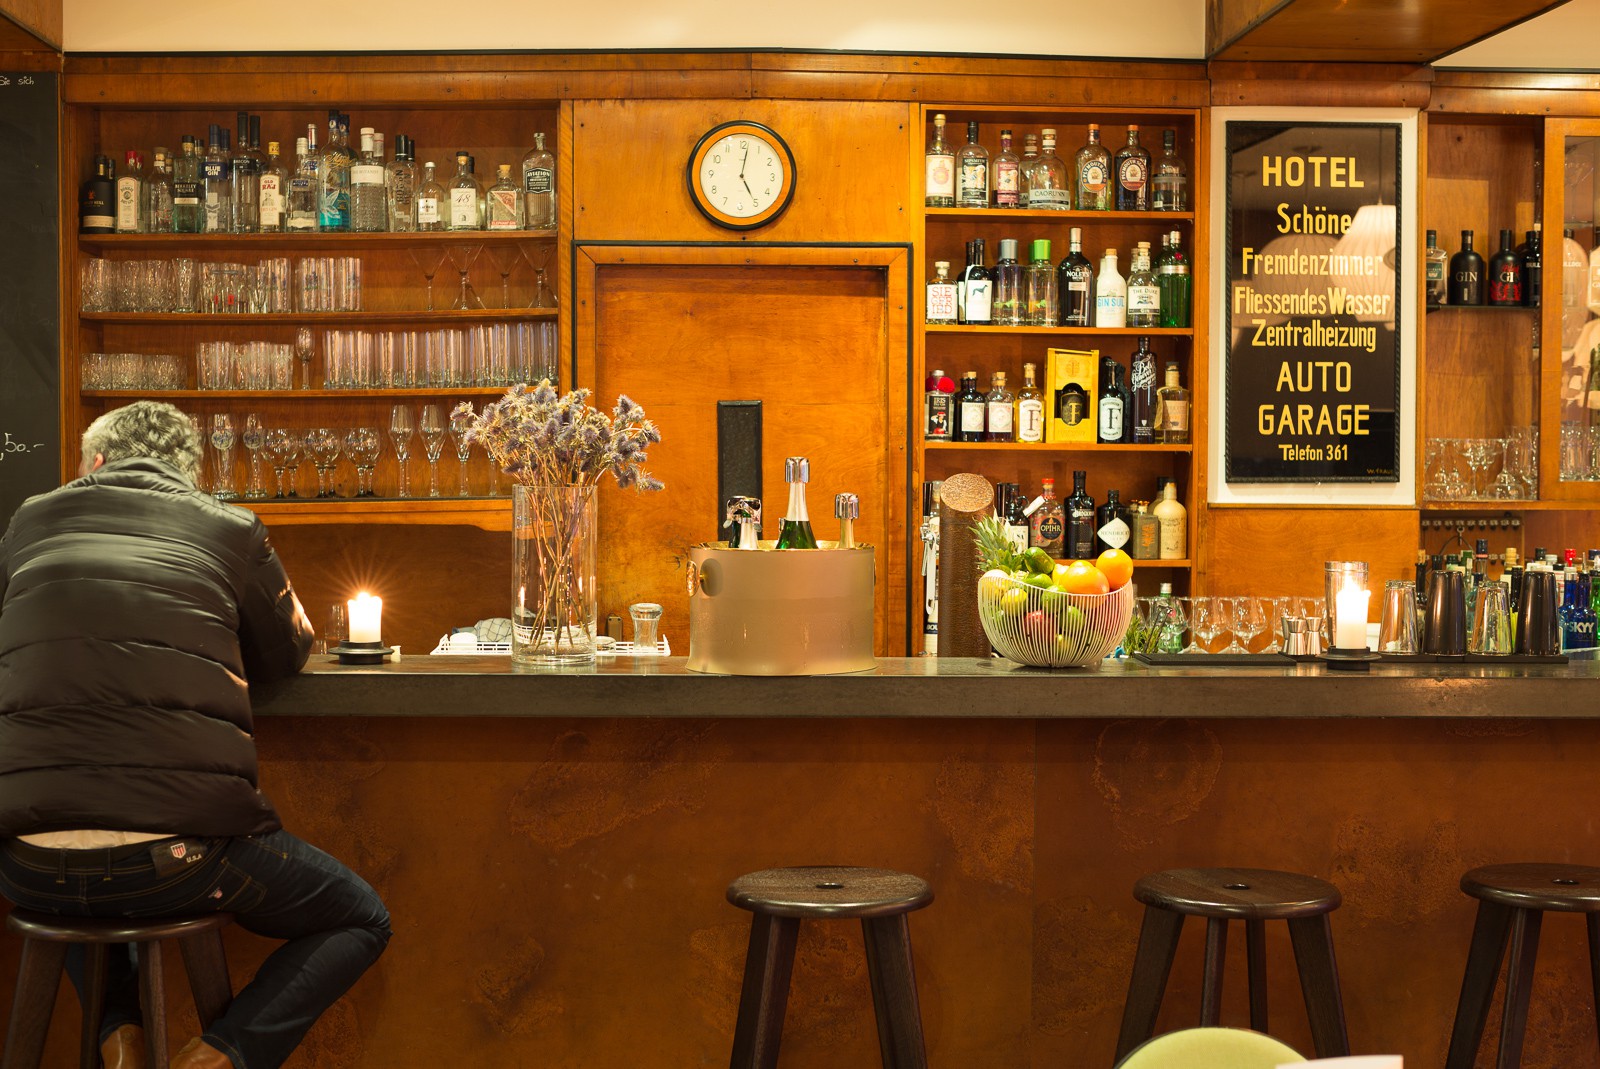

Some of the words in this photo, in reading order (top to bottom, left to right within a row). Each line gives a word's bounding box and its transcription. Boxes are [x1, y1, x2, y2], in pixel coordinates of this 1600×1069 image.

[18, 76, 35, 86] sich
[725, 144, 731, 153] 11
[713, 155, 721, 164] 10
[767, 157, 773, 167] 2
[708, 169, 714, 178] 9
[1262, 155, 1365, 188] HOTEL
[770, 173, 776, 182] 3
[711, 185, 717, 194] 8
[764, 188, 770, 196] 4
[1034, 190, 1065, 198] CAORUNN
[723, 197, 728, 206] 7
[753, 198, 759, 208] 5
[1276, 202, 1352, 235] Schöne
[1242, 247, 1384, 277] Fremdenzimmer
[1455, 271, 1478, 283] GIN
[931, 286, 952, 297] SIE
[1097, 297, 1109, 308] GIN
[1111, 297, 1125, 308] SUL
[1234, 286, 1327, 316] Fliessendes
[1327, 286, 1391, 316] Wasser
[930, 305, 953, 315] IED
[1251, 318, 1377, 353] Zentralheizung
[1275, 361, 1352, 393] AUTO
[1258, 404, 1370, 436] GARAGE
[1278, 444, 1323, 461] Telefon
[1326, 444, 1348, 461] 361
[1040, 524, 1061, 532] OPIHR
[1569, 621, 1595, 633] SKYY
